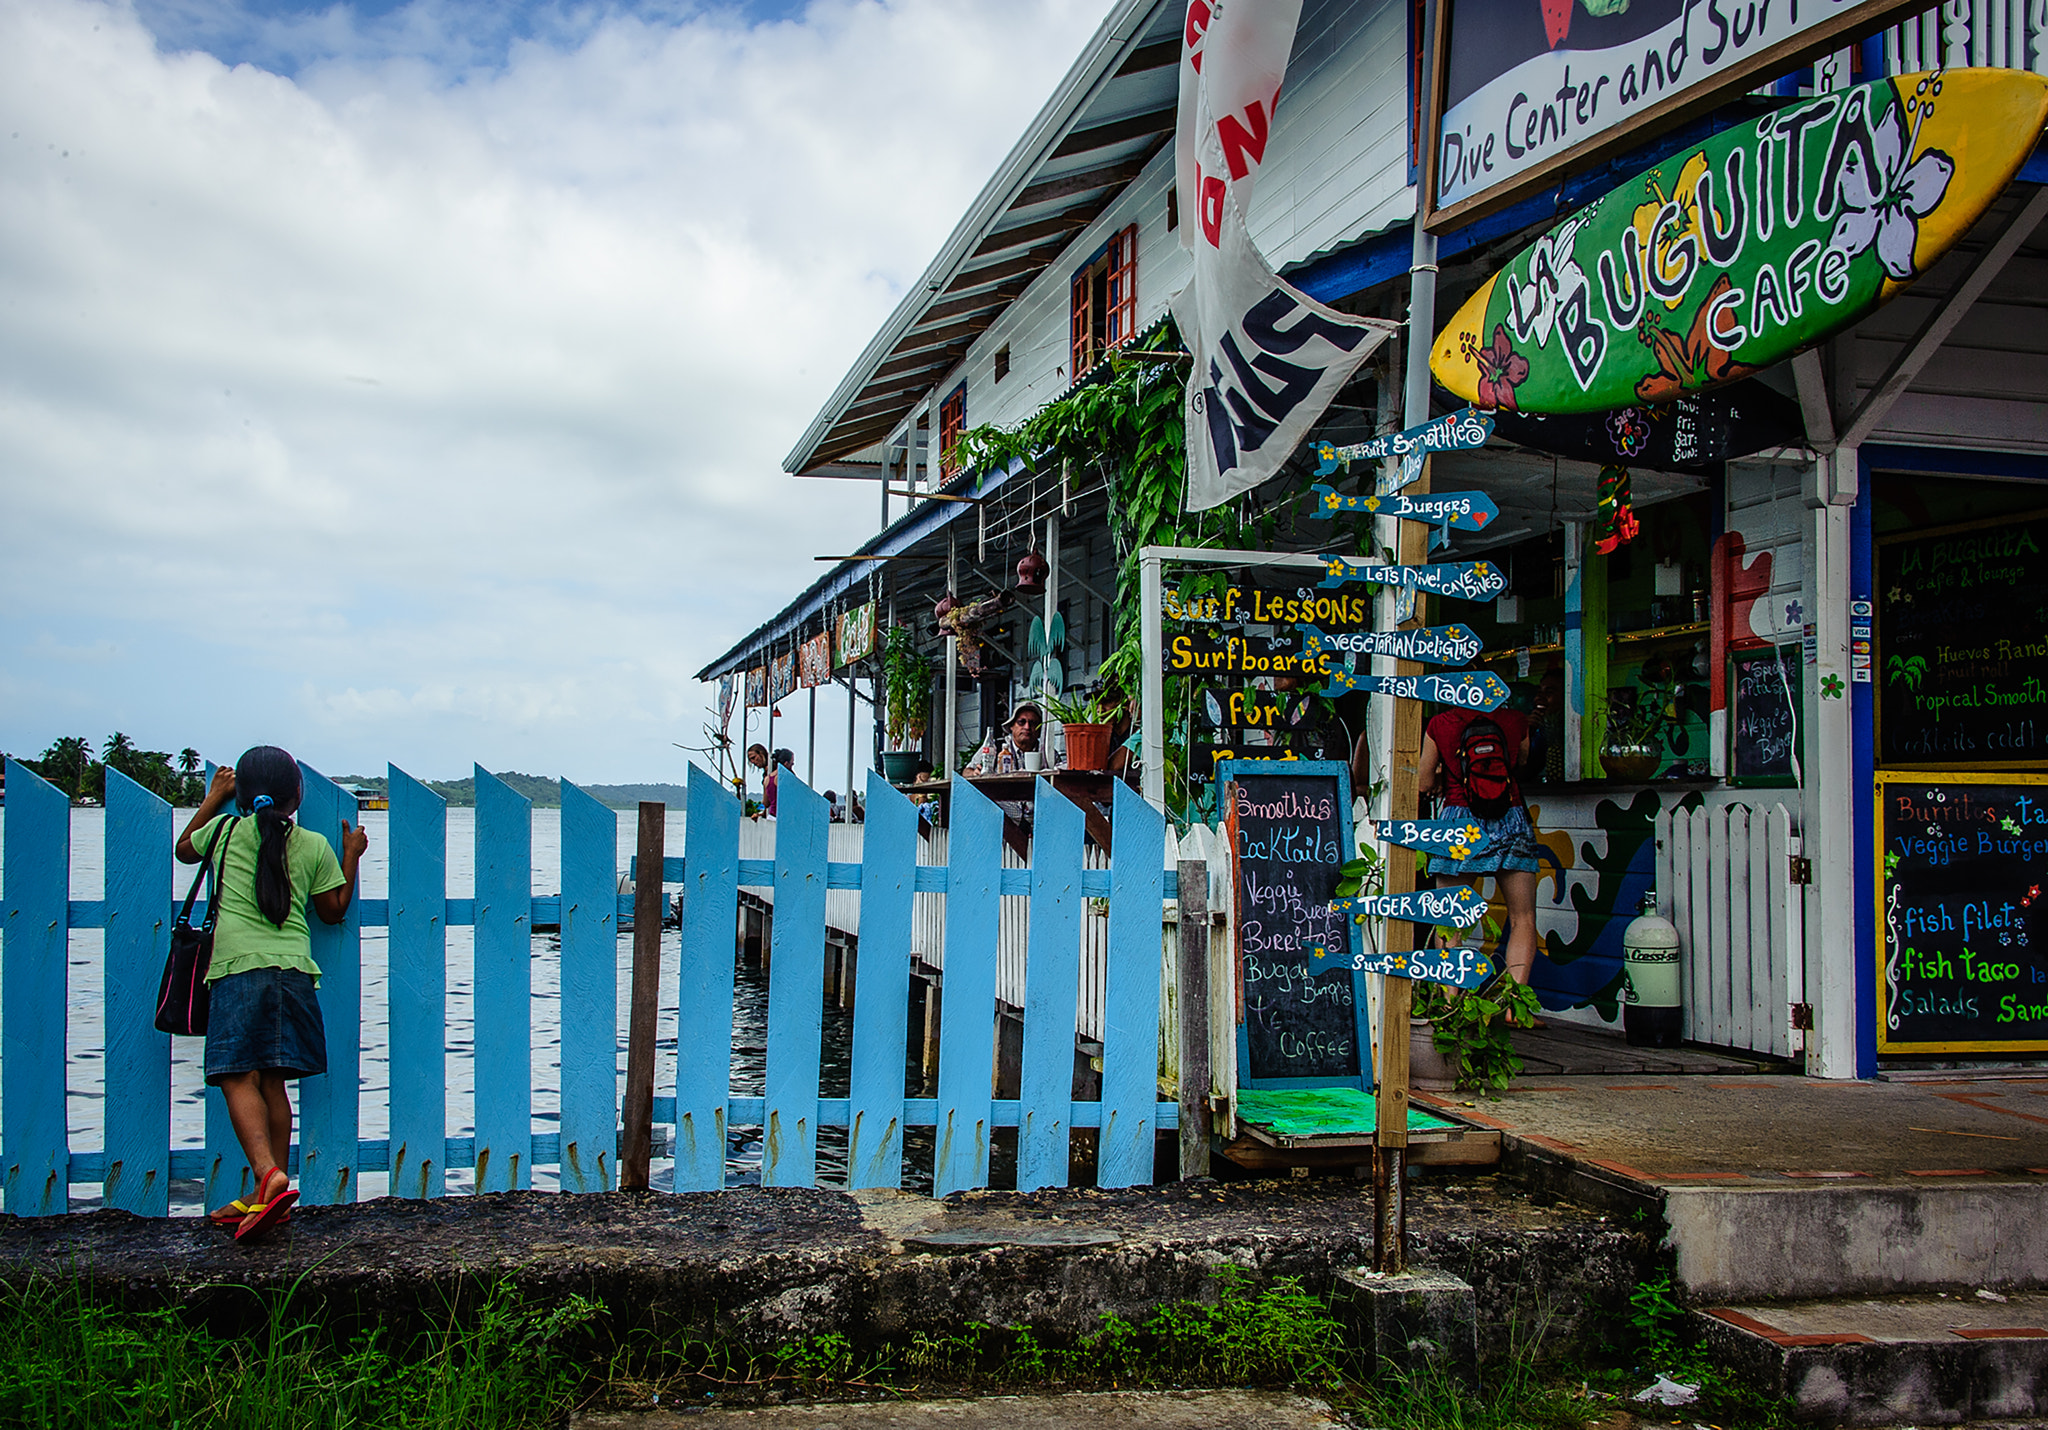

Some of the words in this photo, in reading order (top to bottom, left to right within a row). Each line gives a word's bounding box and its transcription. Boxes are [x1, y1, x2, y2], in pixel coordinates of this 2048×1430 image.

[1441, 119, 1494, 198] Dive
[1505, 64, 1609, 160] Center
[1619, 0, 1688, 106] and
[1507, 236, 1560, 344] LA
[1441, 568, 1473, 595] CAVE
[1977, 562, 2025, 586] lounge
[1163, 588, 1241, 620] Surf
[1936, 645, 1991, 665] Huevos
[1237, 787, 1331, 821] Smoothies
[1400, 822, 1467, 846] BEERS
[1895, 832, 1969, 866] Veggie
[1245, 869, 1302, 914] Veggie
[1904, 903, 1956, 938] fish
[1962, 900, 2016, 943] filet
[1351, 953, 1394, 975] Surf
[1901, 947, 1954, 981] fish
[1958, 947, 2020, 983] taco
[1901, 977, 1979, 1020] Salads
